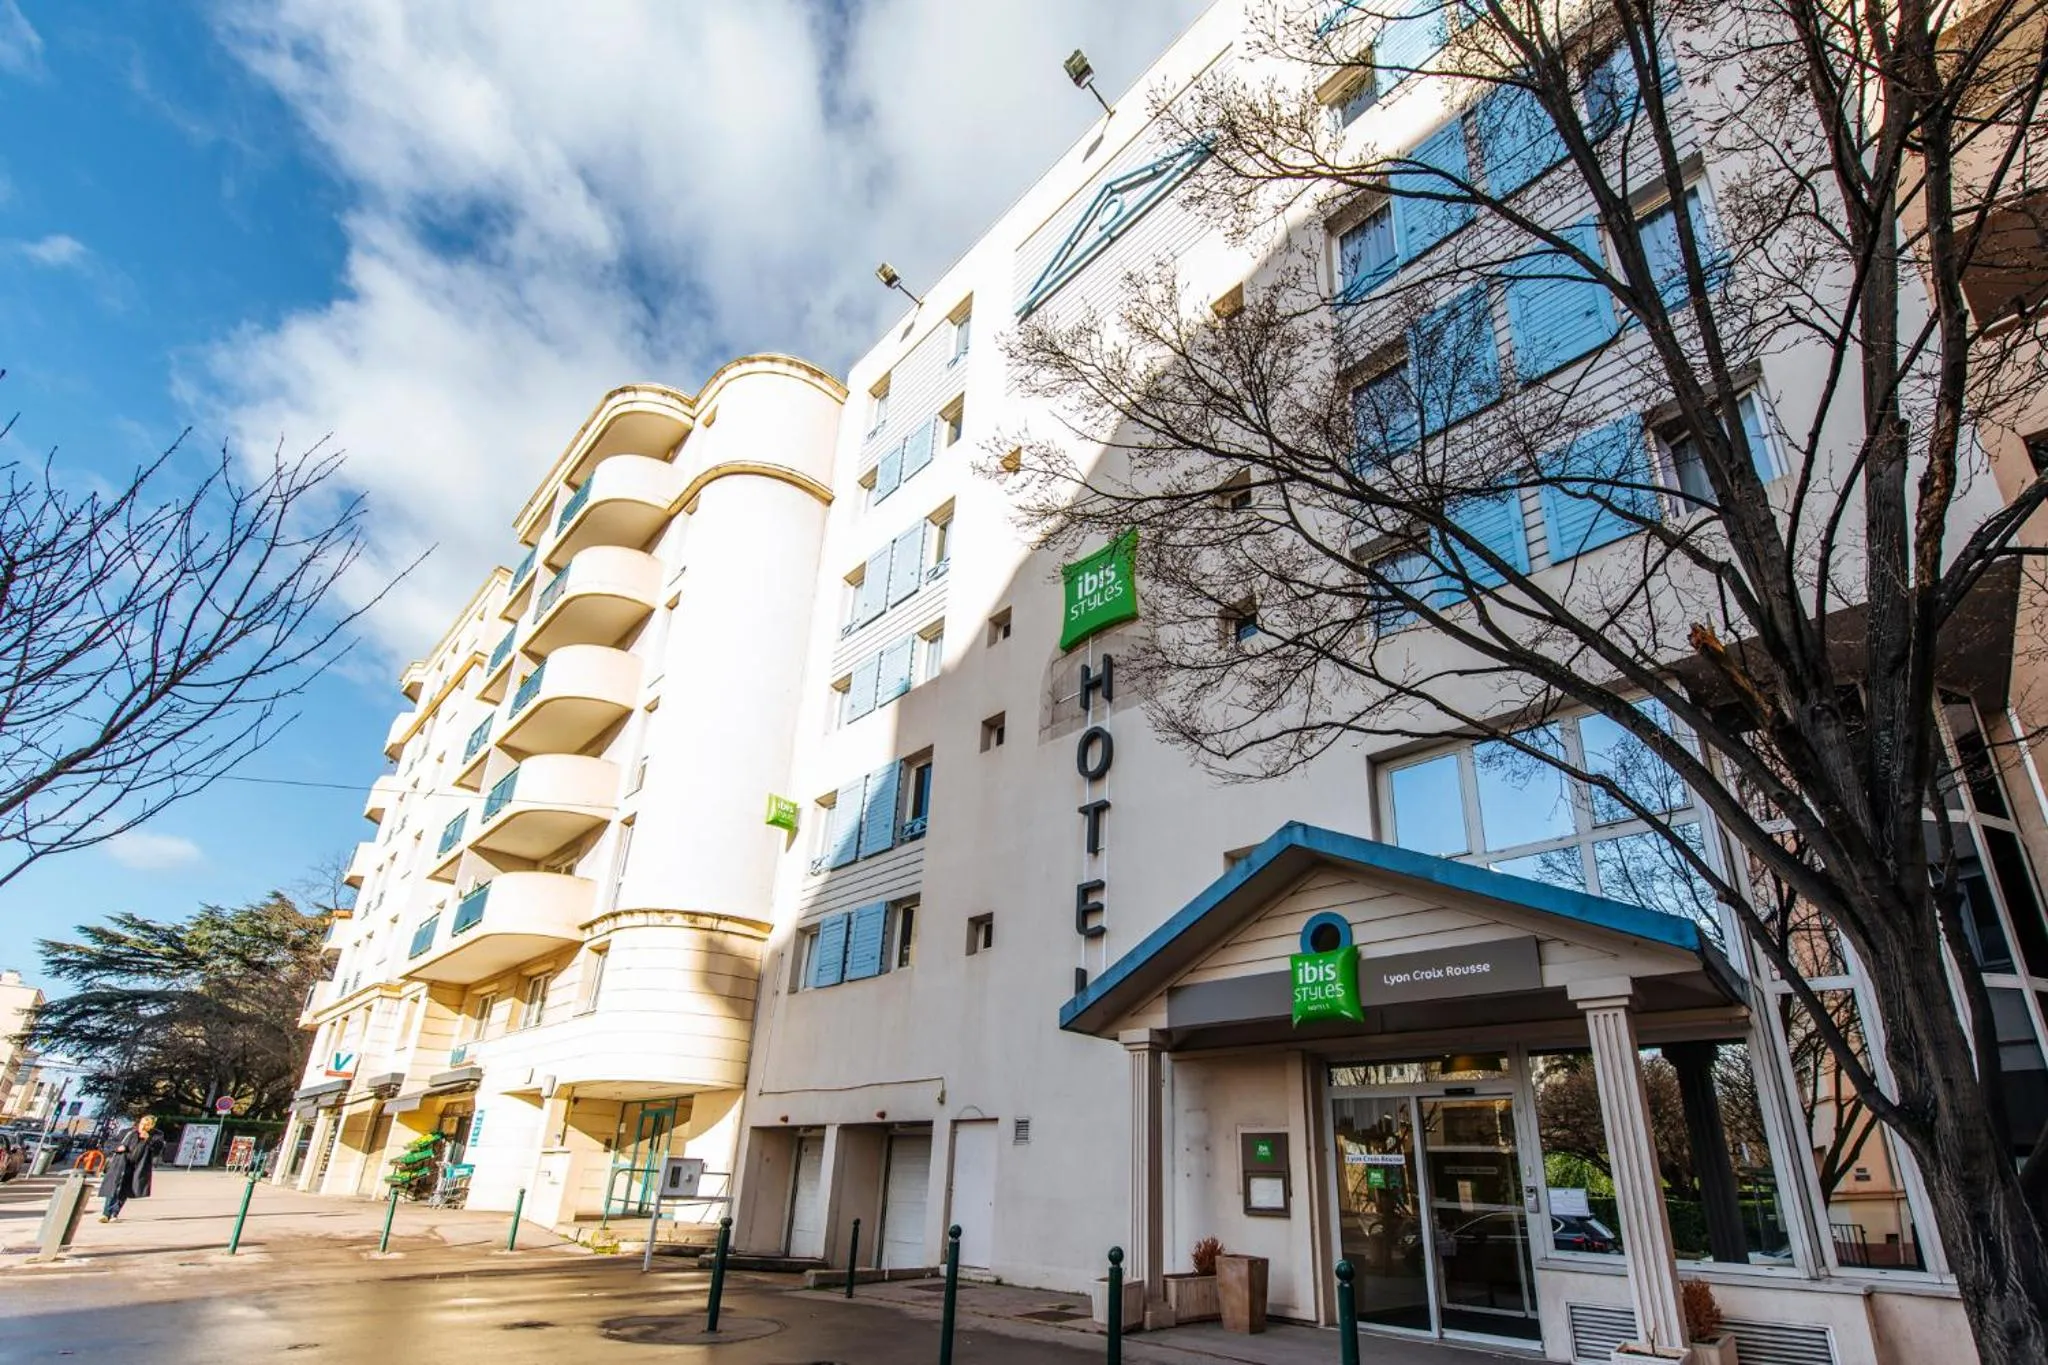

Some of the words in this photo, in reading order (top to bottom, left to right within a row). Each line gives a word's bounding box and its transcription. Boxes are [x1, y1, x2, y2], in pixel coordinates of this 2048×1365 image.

[1077, 563, 1116, 600] ibis
[1298, 959, 1336, 984] ibis
[1383, 973, 1411, 986] Lyon
[1412, 967, 1444, 981] Croix
[1445, 963, 1491, 977] Rousse
